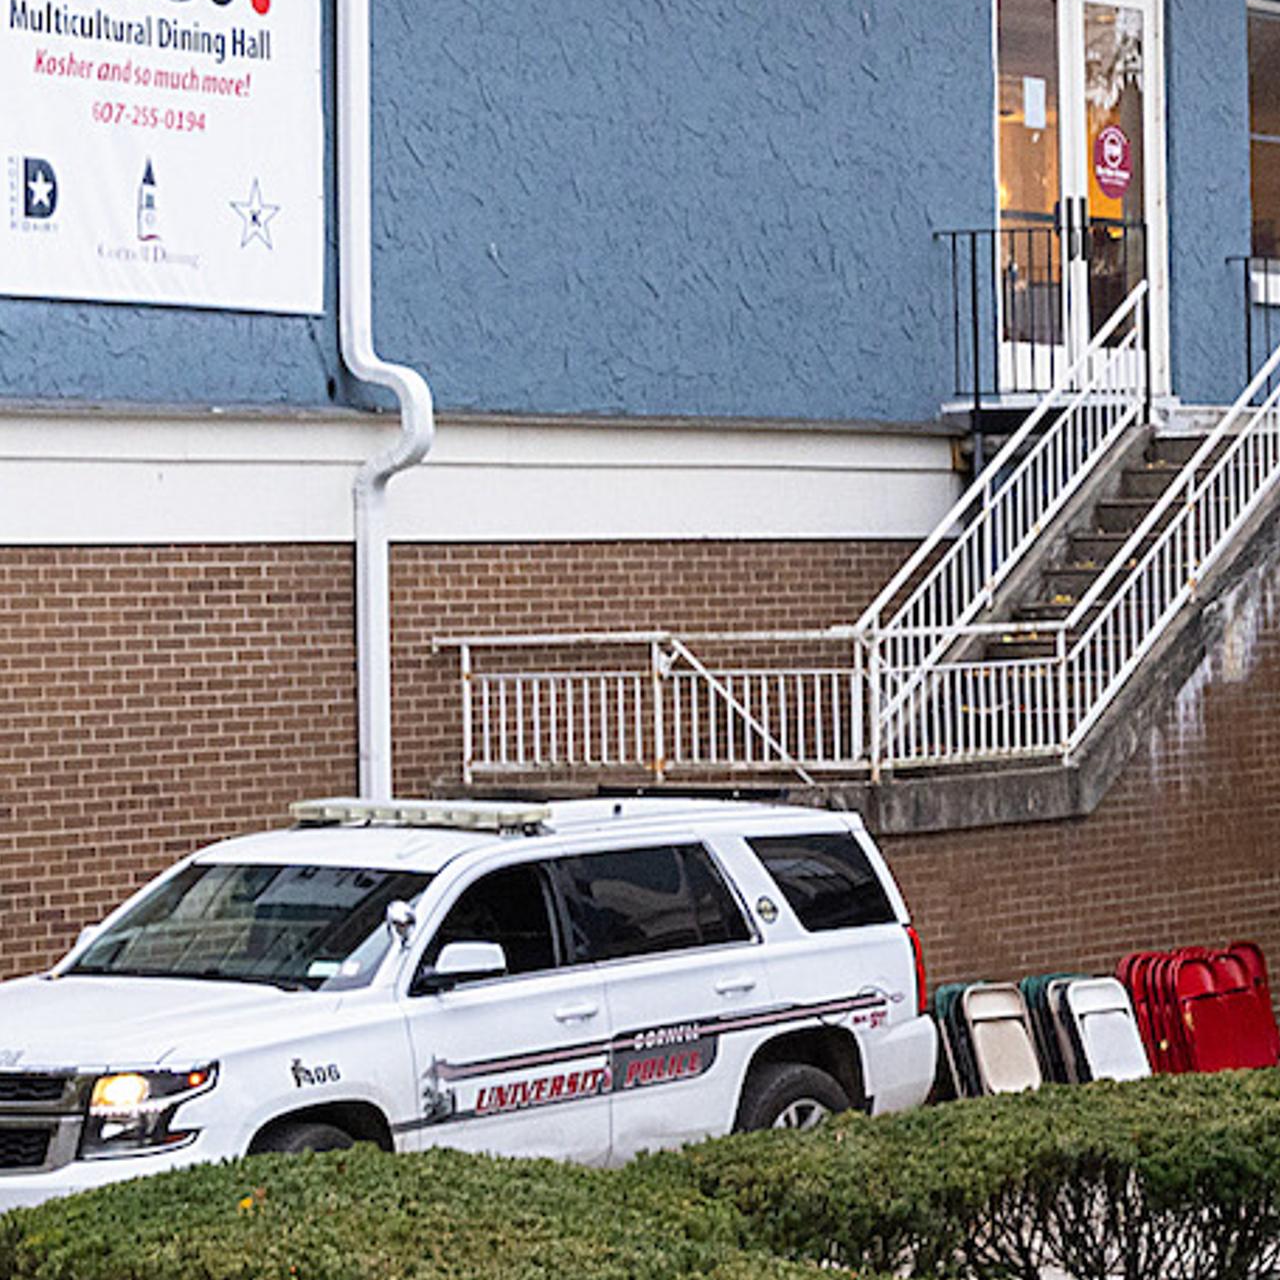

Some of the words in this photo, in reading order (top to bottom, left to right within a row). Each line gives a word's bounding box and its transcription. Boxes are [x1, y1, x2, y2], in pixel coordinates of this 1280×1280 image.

[158, 18, 226, 63] Dining
[232, 27, 271, 60] Hall
[33, 48, 94, 80] Kosher
[97, 59, 132, 83] and
[134, 68, 150, 87] so
[154, 67, 200, 90] much
[202, 73, 251, 97] more!
[92, 102, 206, 132] 607-255-0194
[624, 1051, 701, 1088] POLICE
